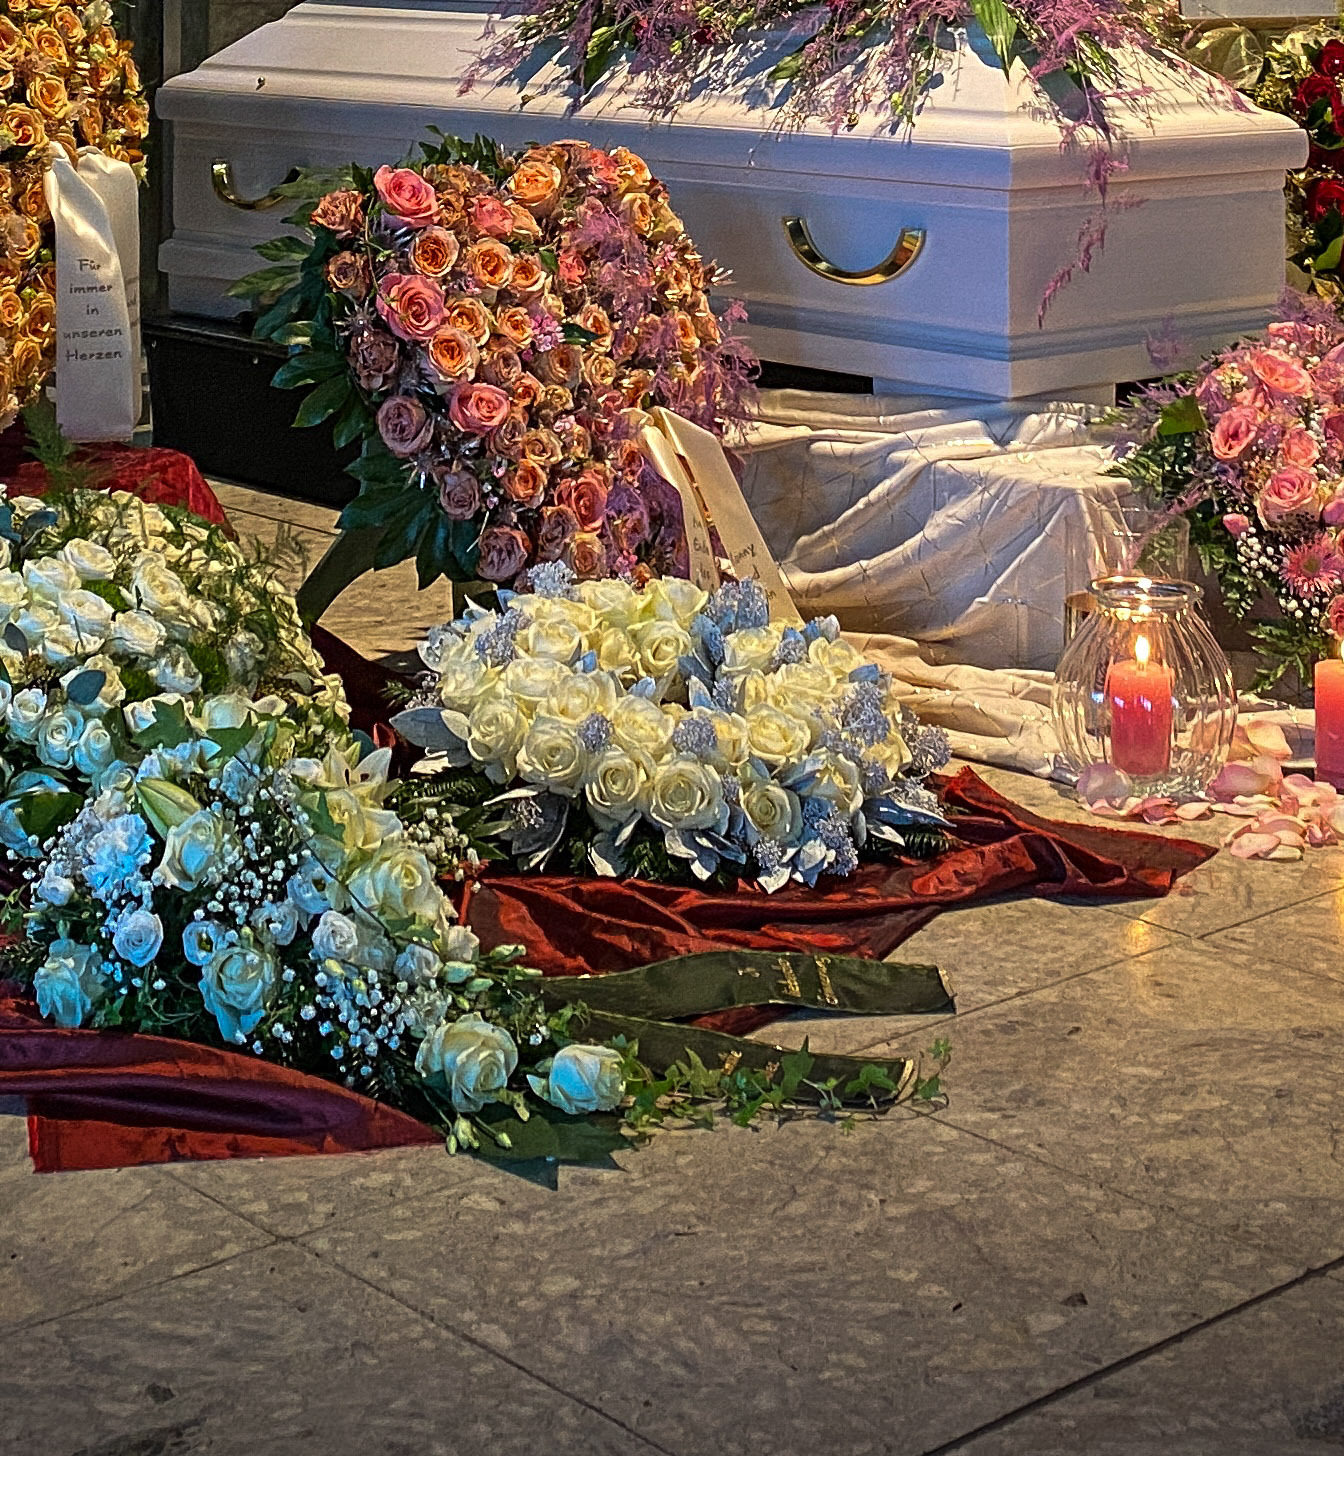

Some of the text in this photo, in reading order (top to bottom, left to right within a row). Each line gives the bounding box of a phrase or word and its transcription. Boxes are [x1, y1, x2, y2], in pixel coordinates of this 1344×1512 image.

[77, 258, 101, 272] Für
[69, 283, 113, 294] immer
[86, 304, 100, 316] in
[63, 328, 124, 340] unseren
[65, 349, 123, 362] Herzen
